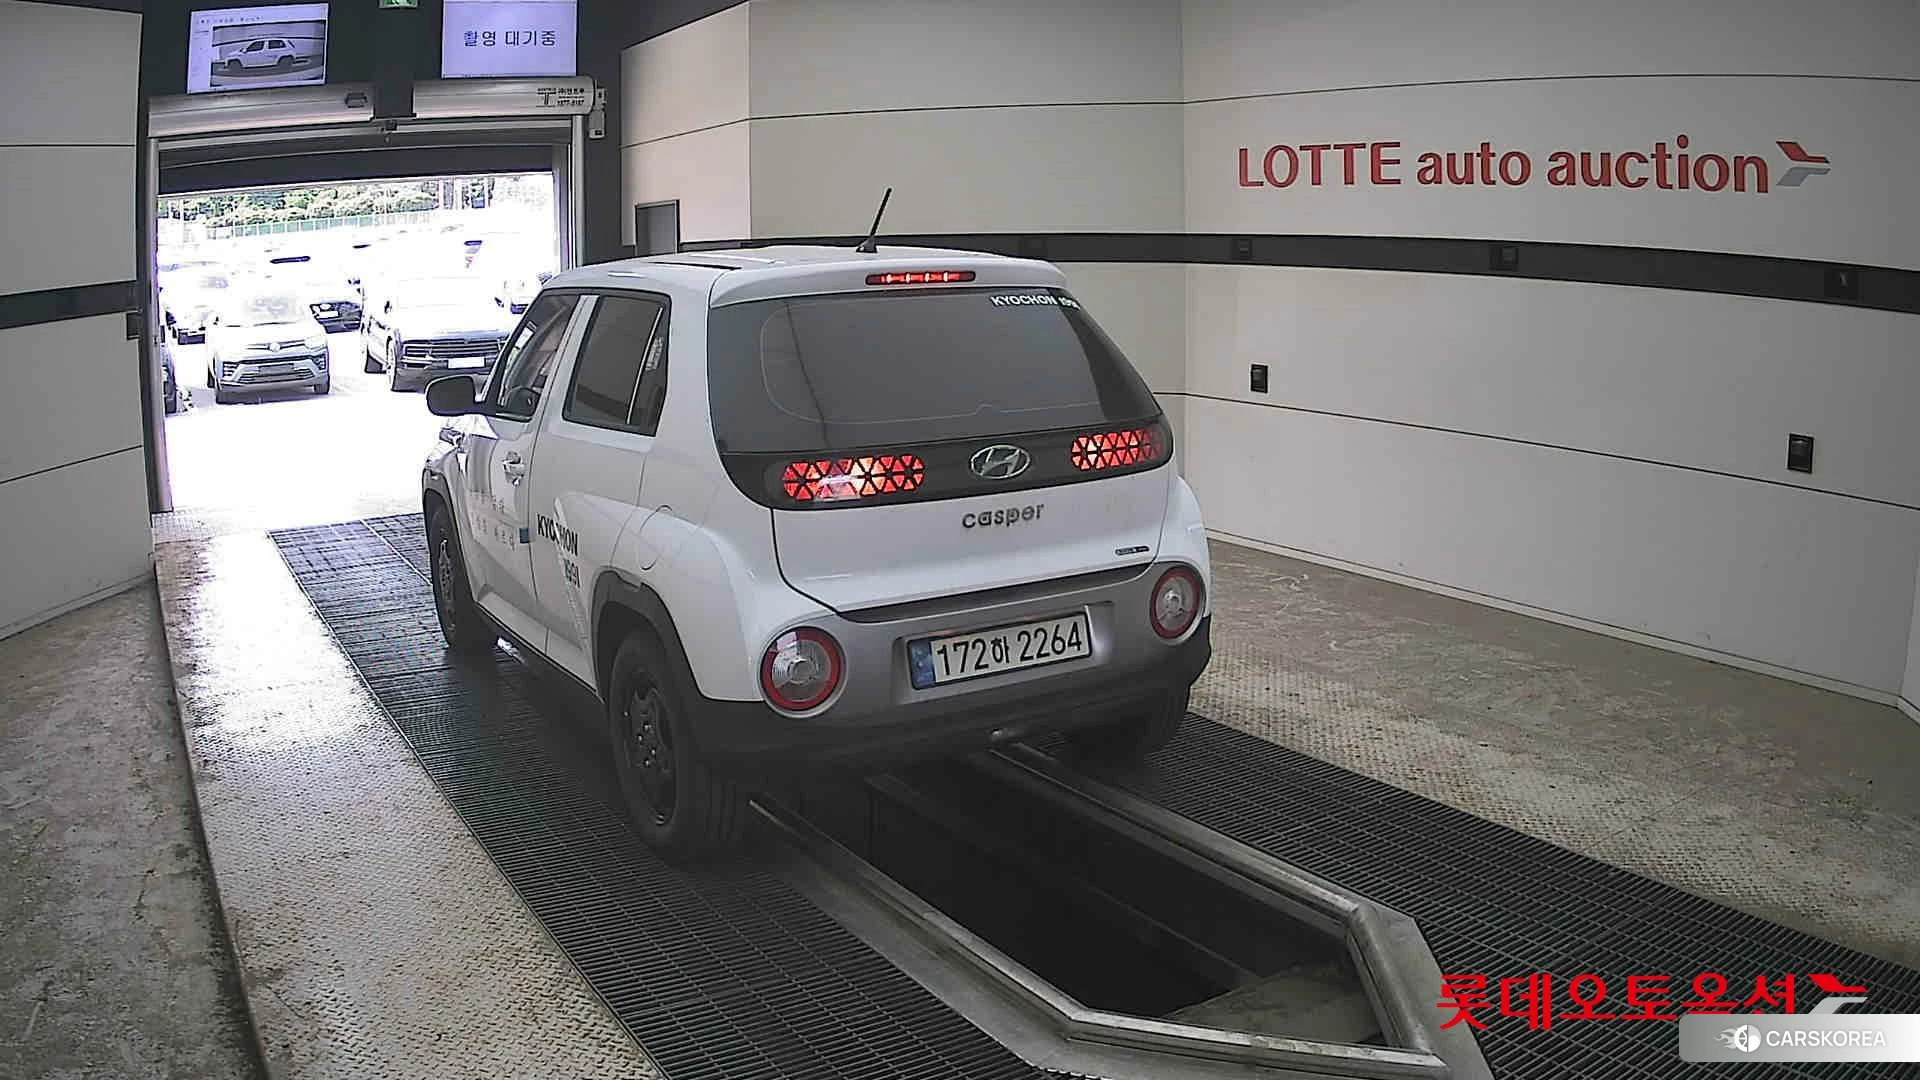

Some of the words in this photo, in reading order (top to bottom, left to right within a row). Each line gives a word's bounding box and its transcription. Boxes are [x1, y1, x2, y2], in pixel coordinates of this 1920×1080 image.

[505, 30, 557, 47] 대기중
[1239, 141, 1402, 188] LOTTE
[1416, 142, 1532, 186] auto
[1547, 134, 1769, 194] auction
[990, 295, 1058, 306] KYOCHON
[962, 503, 1045, 528] casper
[937, 636, 1010, 676] 172하
[1017, 621, 1082, 662] 2264
